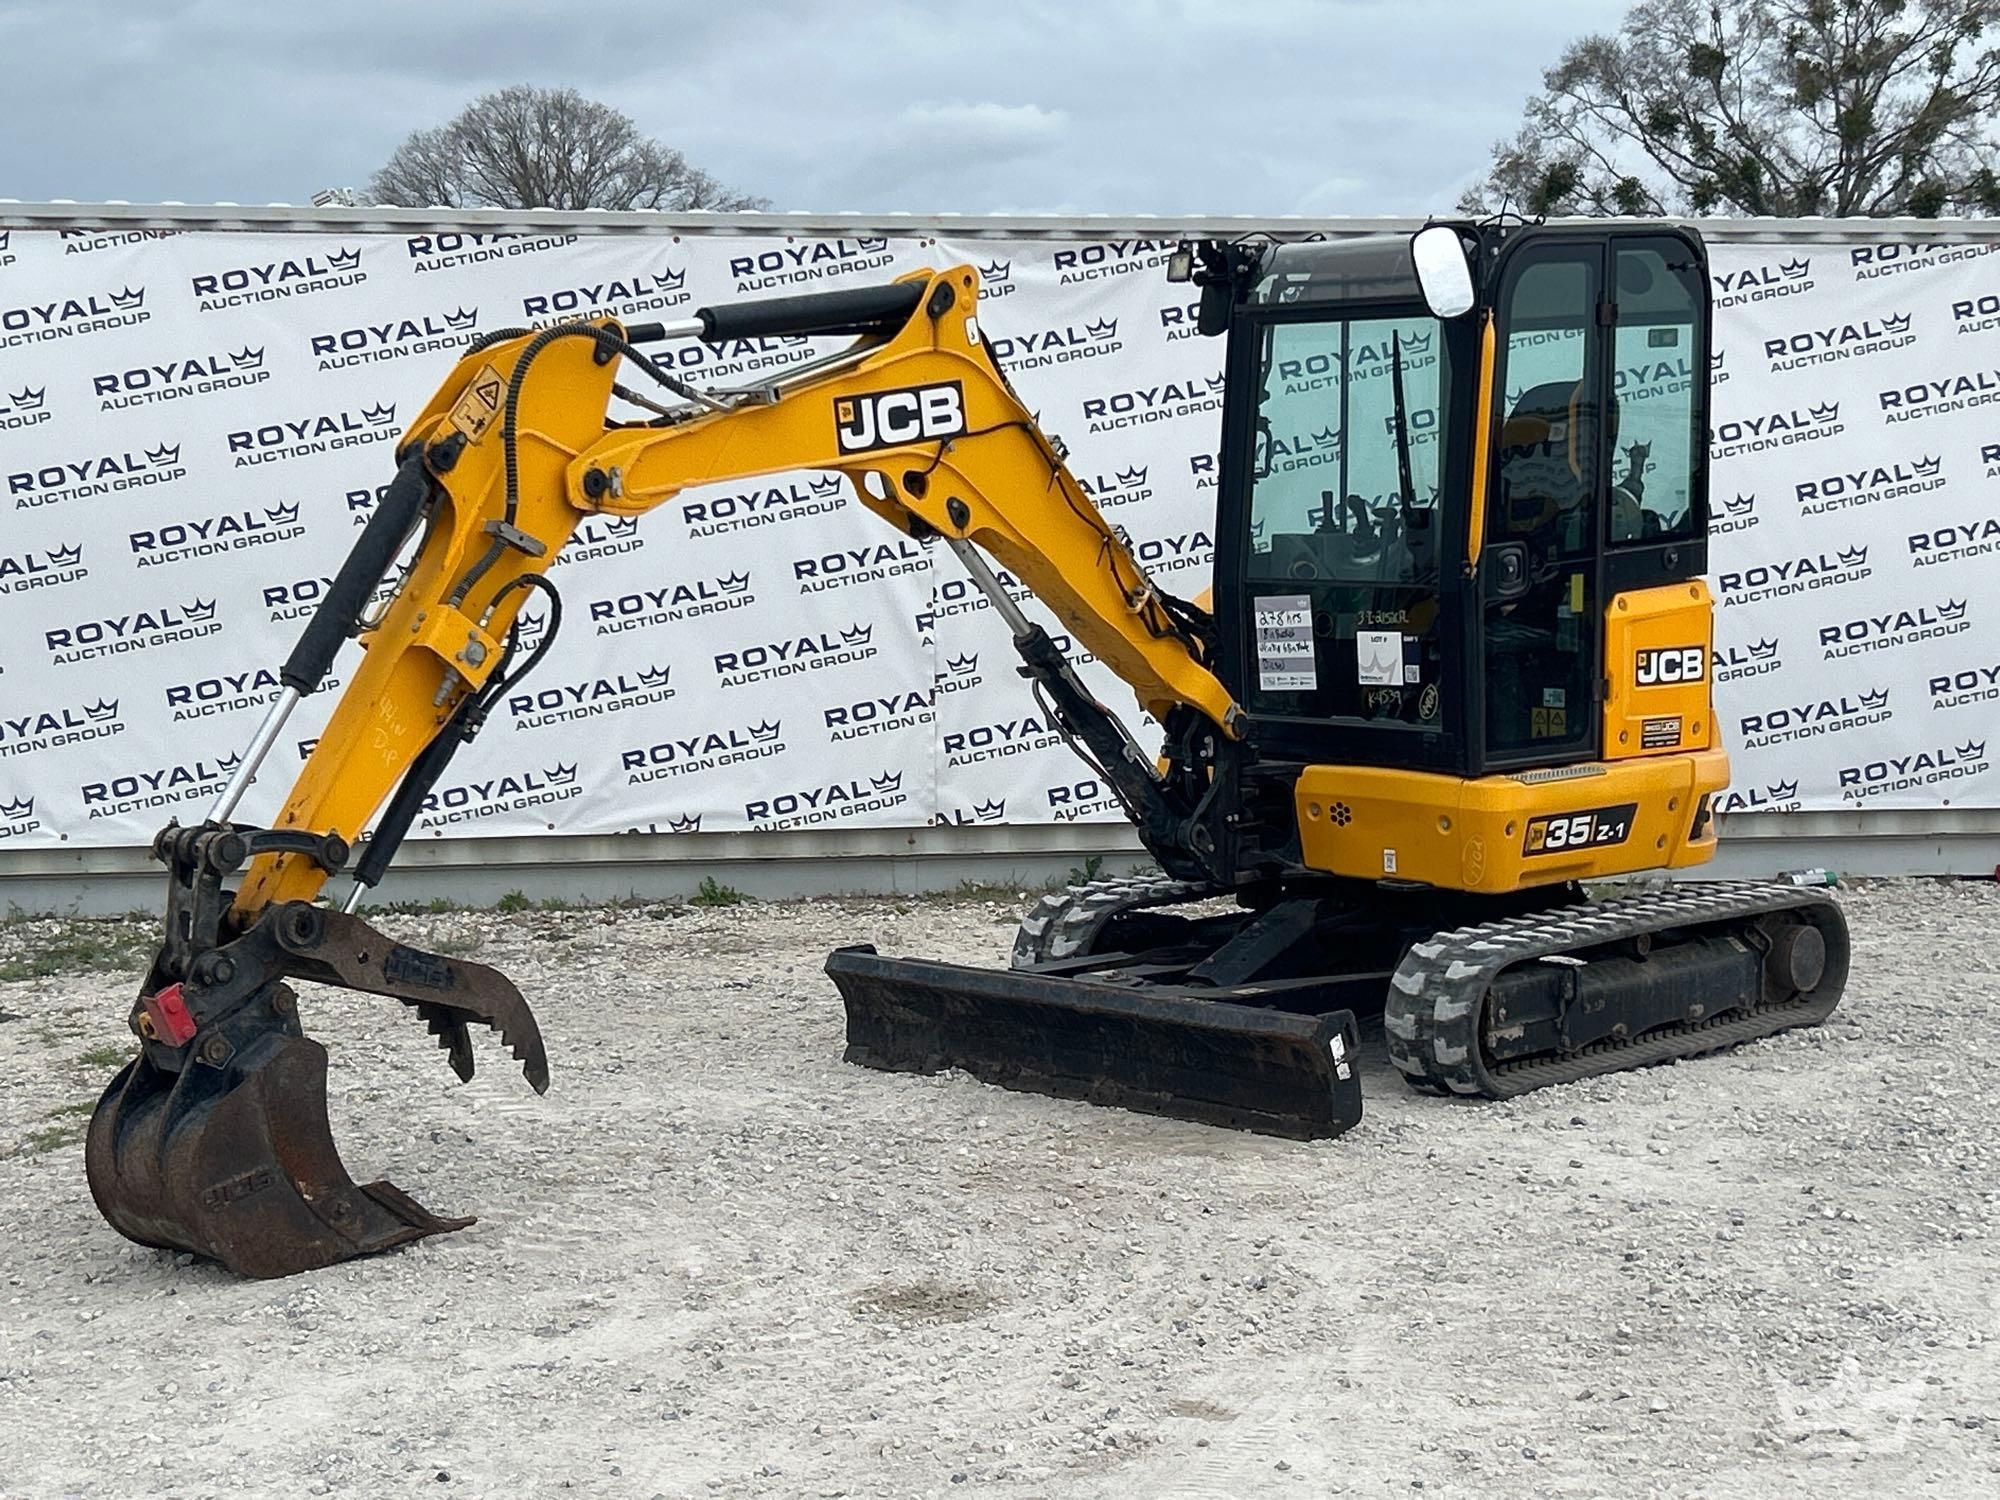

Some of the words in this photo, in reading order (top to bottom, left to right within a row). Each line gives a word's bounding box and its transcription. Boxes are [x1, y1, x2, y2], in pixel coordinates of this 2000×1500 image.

[415, 248, 503, 272] AUCTION
[508, 234, 578, 256] GROUP
[730, 240, 857, 277] ROYAL
[1857, 258, 1934, 280] AUCTION
[193, 258, 328, 296] ROYAL
[738, 268, 822, 292] AUCTION
[827, 255, 893, 275] GROUP
[1061, 261, 1143, 285] AUCTION
[1713, 266, 1780, 294] YAL
[1751, 280, 1815, 301] GROUP
[201, 287, 290, 311] AUCTION
[296, 273, 366, 294] GROUP
[524, 278, 653, 317] ROYAL
[623, 293, 690, 314] GROUP
[977, 284, 1016, 300] OUP
[0, 326, 73, 349] UCTION
[78, 312, 150, 333] GROUP
[2, 297, 110, 331] OYAL
[311, 317, 445, 356] ROYAL
[992, 327, 1087, 359] OYAL
[1508, 332, 1560, 350] CTION
[1765, 322, 1882, 358] ROYAL
[1772, 349, 1849, 372] AUCTION
[1854, 336, 1915, 355] GROUP
[319, 346, 408, 371] AUCTION
[680, 362, 744, 383] CTION
[748, 349, 815, 369] GROUP
[1000, 354, 1053, 374] CTION
[1057, 341, 1123, 363] GROUP
[94, 357, 230, 396] ROYAL
[102, 386, 193, 411] AUCTION
[198, 372, 269, 393] GROUP
[1617, 384, 1665, 405] TION
[1880, 373, 1995, 409] ROYAL
[841, 386, 964, 450] JCB
[1083, 381, 1206, 419] ROYAL
[1886, 400, 1963, 423] AUCTION
[1968, 388, 2000, 407] GRO
[0, 411, 51, 432] ROUP
[228, 413, 362, 452] ROYAL
[1090, 409, 1172, 433] AUCTION
[236, 442, 325, 467] AUCTION
[331, 428, 401, 449] GROUP
[1711, 437, 1779, 460] UCTION
[1781, 423, 1845, 446] GROUP
[8, 454, 146, 494] ROYAL
[16, 483, 108, 509] AUCTION
[114, 469, 186, 490] GROUP
[1796, 465, 1912, 502] ROYAL
[683, 485, 810, 524] ROYAL
[1802, 492, 1880, 516] AUCTION
[1885, 479, 1945, 498] GROUP
[130, 512, 266, 552] ROYAL
[690, 513, 775, 538] AUCTION
[780, 499, 846, 520] GROUP
[1708, 516, 1760, 537] ROUP
[1908, 519, 2000, 554] ROYA
[138, 541, 228, 567] AUCTION
[234, 527, 305, 548] GROUP
[575, 539, 644, 562] GROUP
[794, 541, 918, 580] ROYAL
[1138, 531, 1214, 562] OYA
[1142, 553, 1201, 576] CTION
[1914, 544, 1991, 567] AUCTION
[15, 569, 87, 591] GROUP
[801, 569, 884, 594] AUCTION
[889, 559, 933, 577] GRO
[1720, 555, 1837, 592] ROYAL
[1725, 583, 1804, 607] AUCTION
[1809, 569, 1871, 589] GROUP
[590, 582, 718, 621] ROYAL
[597, 610, 682, 635] AUCTION
[687, 596, 754, 617] GROUP
[933, 597, 991, 618] UCTIO
[46, 609, 183, 650] ROYAL
[54, 638, 145, 665] AUCTION
[150, 623, 222, 645] GROUP
[1820, 608, 1937, 646] ROYAL
[1824, 636, 1903, 660] AUCTION
[1908, 622, 1970, 642] GROUP
[715, 634, 841, 673] ROYAL
[722, 662, 805, 688] AUCTION
[810, 648, 877, 669] GROUP
[1638, 649, 1703, 683] JCB
[1718, 660, 1782, 683] GROUP
[166, 669, 279, 707] ROYA
[509, 676, 638, 716] ROYAL
[935, 675, 983, 696] ROUP
[1929, 664, 2000, 697] ROY
[1933, 687, 2000, 711] AUCTIO
[0, 709, 85, 741] YAL
[174, 695, 264, 721] AUCTION
[516, 705, 603, 730] AUCTION
[608, 689, 675, 711] GROUP
[1741, 698, 1859, 735] ROYAL
[0, 739, 47, 757] TION
[52, 723, 124, 746] GROUP
[831, 716, 914, 742] AUCTION
[944, 717, 1045, 754] ROYA
[1745, 725, 1825, 749] AUCTION
[1829, 711, 1892, 731] GROUP
[622, 731, 749, 770] ROYAL
[629, 759, 714, 785] AUCTION
[719, 744, 785, 765] GROUP
[949, 742, 1030, 767] AUCTION
[1839, 750, 1955, 787] ROYAL
[82, 763, 218, 804] ROYAL
[89, 792, 180, 819] AUCTION
[185, 776, 257, 800] GRO
[417, 773, 546, 814] ROYAL
[1843, 777, 1922, 800] AUCTION
[1927, 763, 1989, 783] GROUP
[421, 802, 509, 829] AUCTION
[514, 787, 582, 809] GROUP
[746, 782, 871, 821] ROYAL
[841, 794, 906, 816] GROUP
[1053, 798, 1121, 821] AUCTIO
[0, 820, 40, 839] OUP
[1546, 815, 1591, 848] 35
